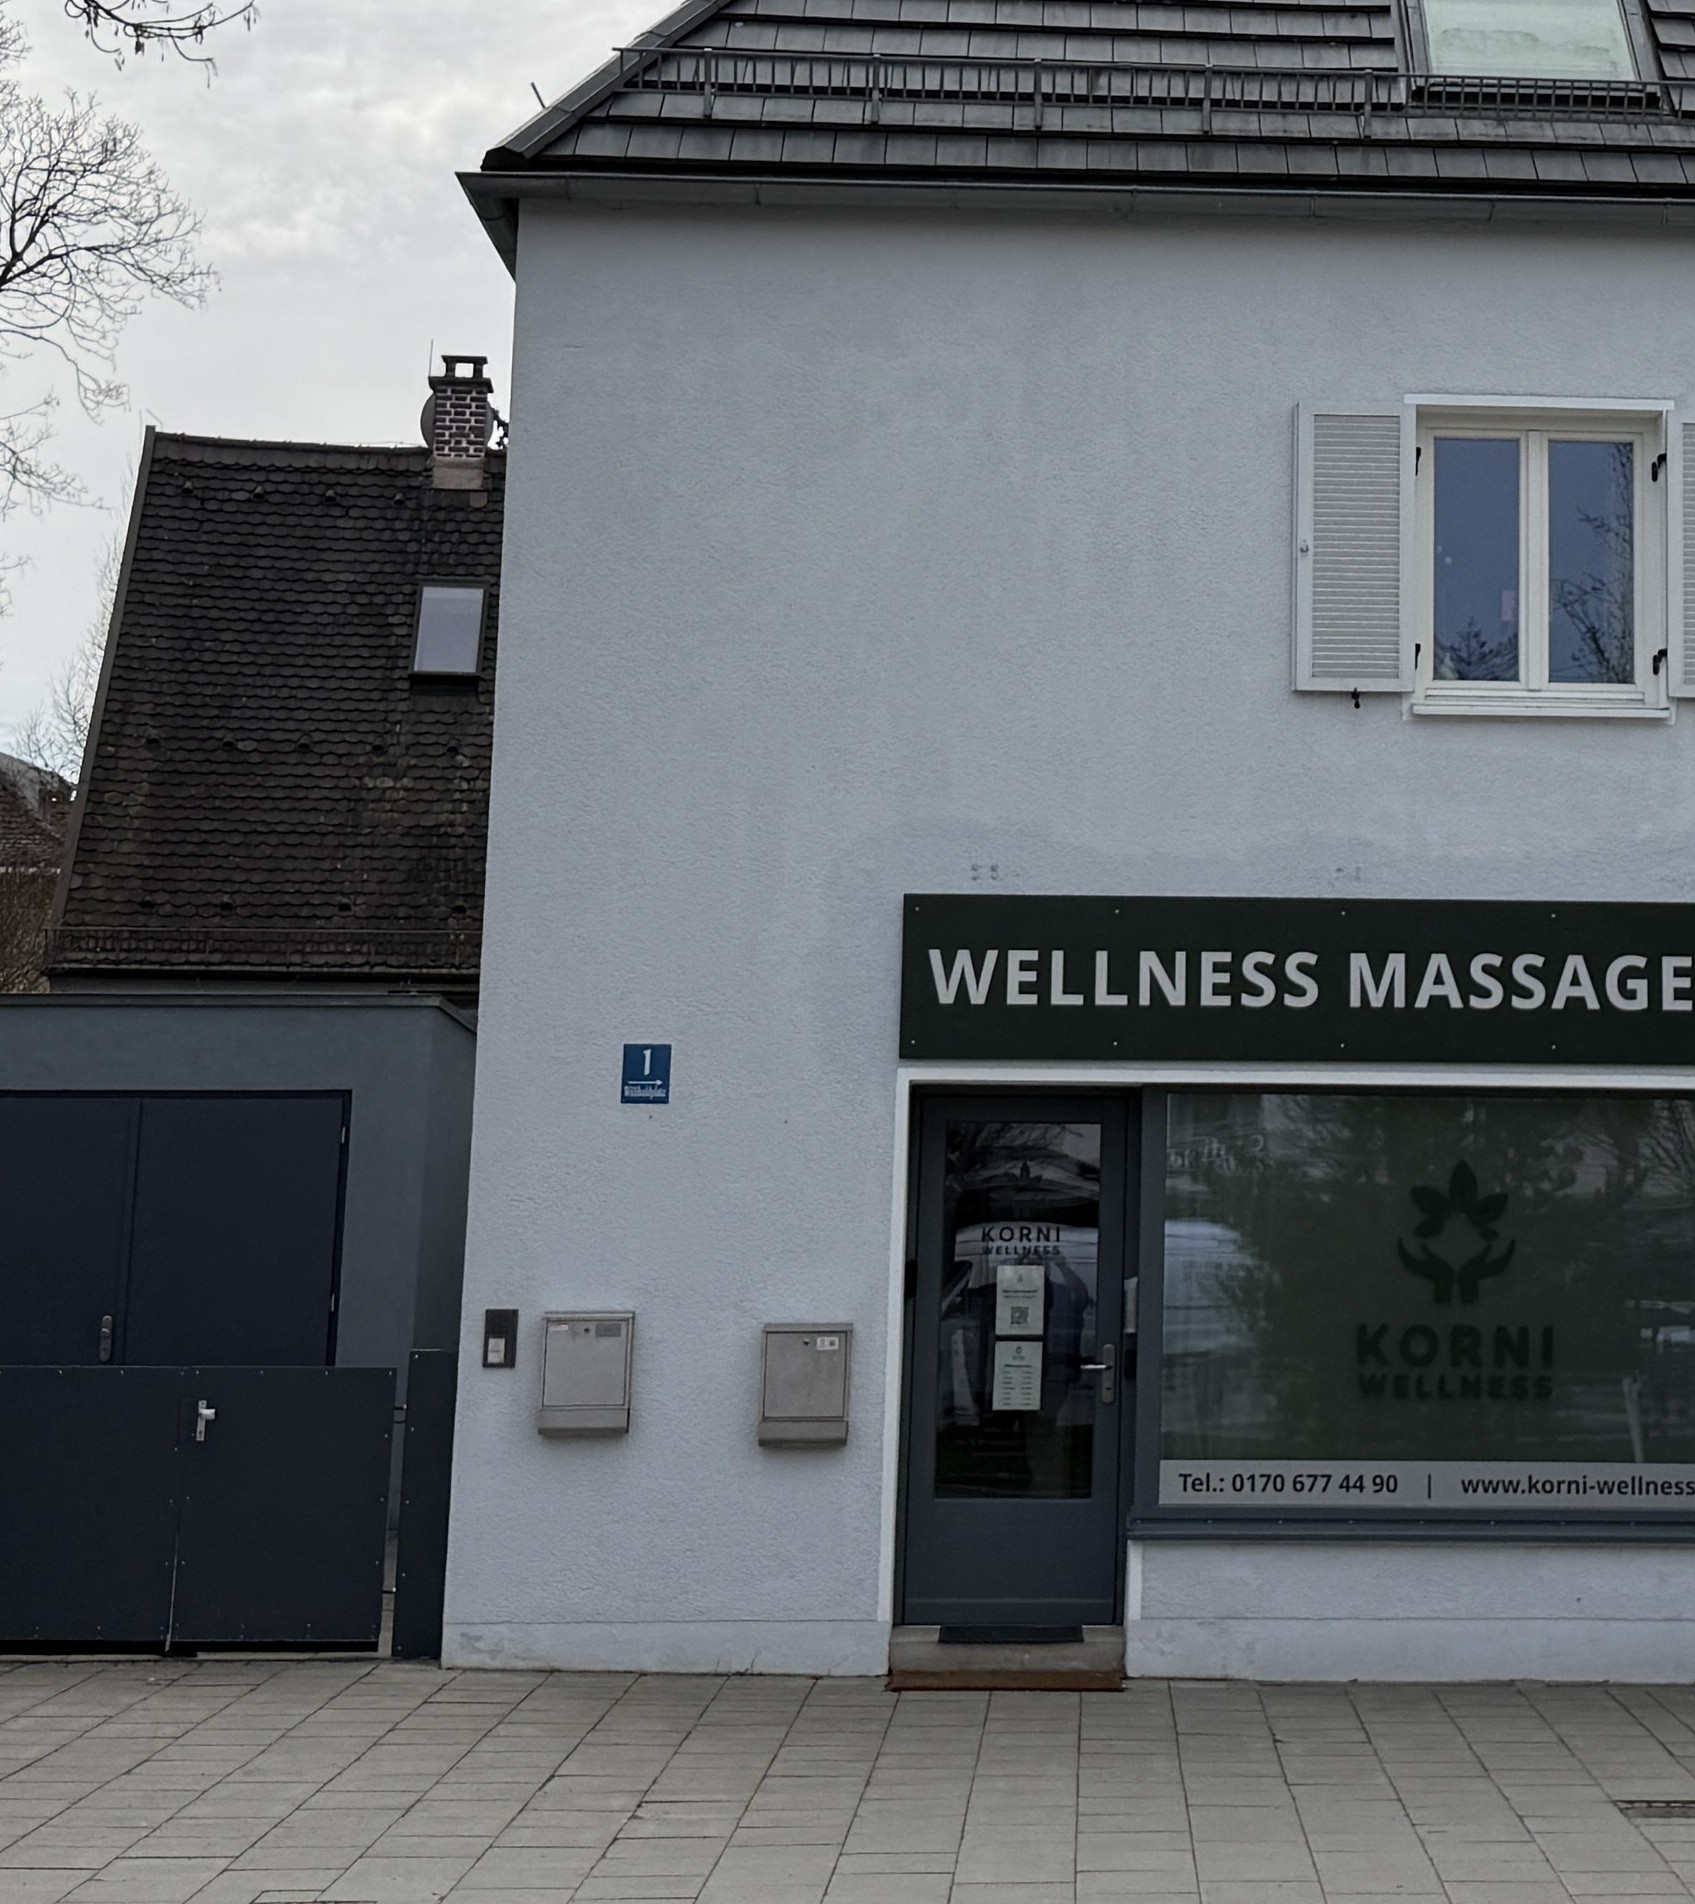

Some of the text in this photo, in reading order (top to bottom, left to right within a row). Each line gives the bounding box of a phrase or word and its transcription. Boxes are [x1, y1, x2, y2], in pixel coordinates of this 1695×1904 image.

[928, 948, 1319, 1008] WELLNESS
[642, 1048, 652, 1076] 1
[981, 1225, 1060, 1243] KORNI
[981, 1244, 1061, 1256] WELLNESS
[1356, 1323, 1554, 1369] KORNI
[1357, 1373, 1554, 1401] WELLNESS
[1178, 1472, 1225, 1493] Tel.:
[1231, 1473, 1286, 1493] 0170
[1292, 1473, 1333, 1493] 677
[1338, 1474, 1365, 1494] 44
[1372, 1474, 1398, 1494] 90
